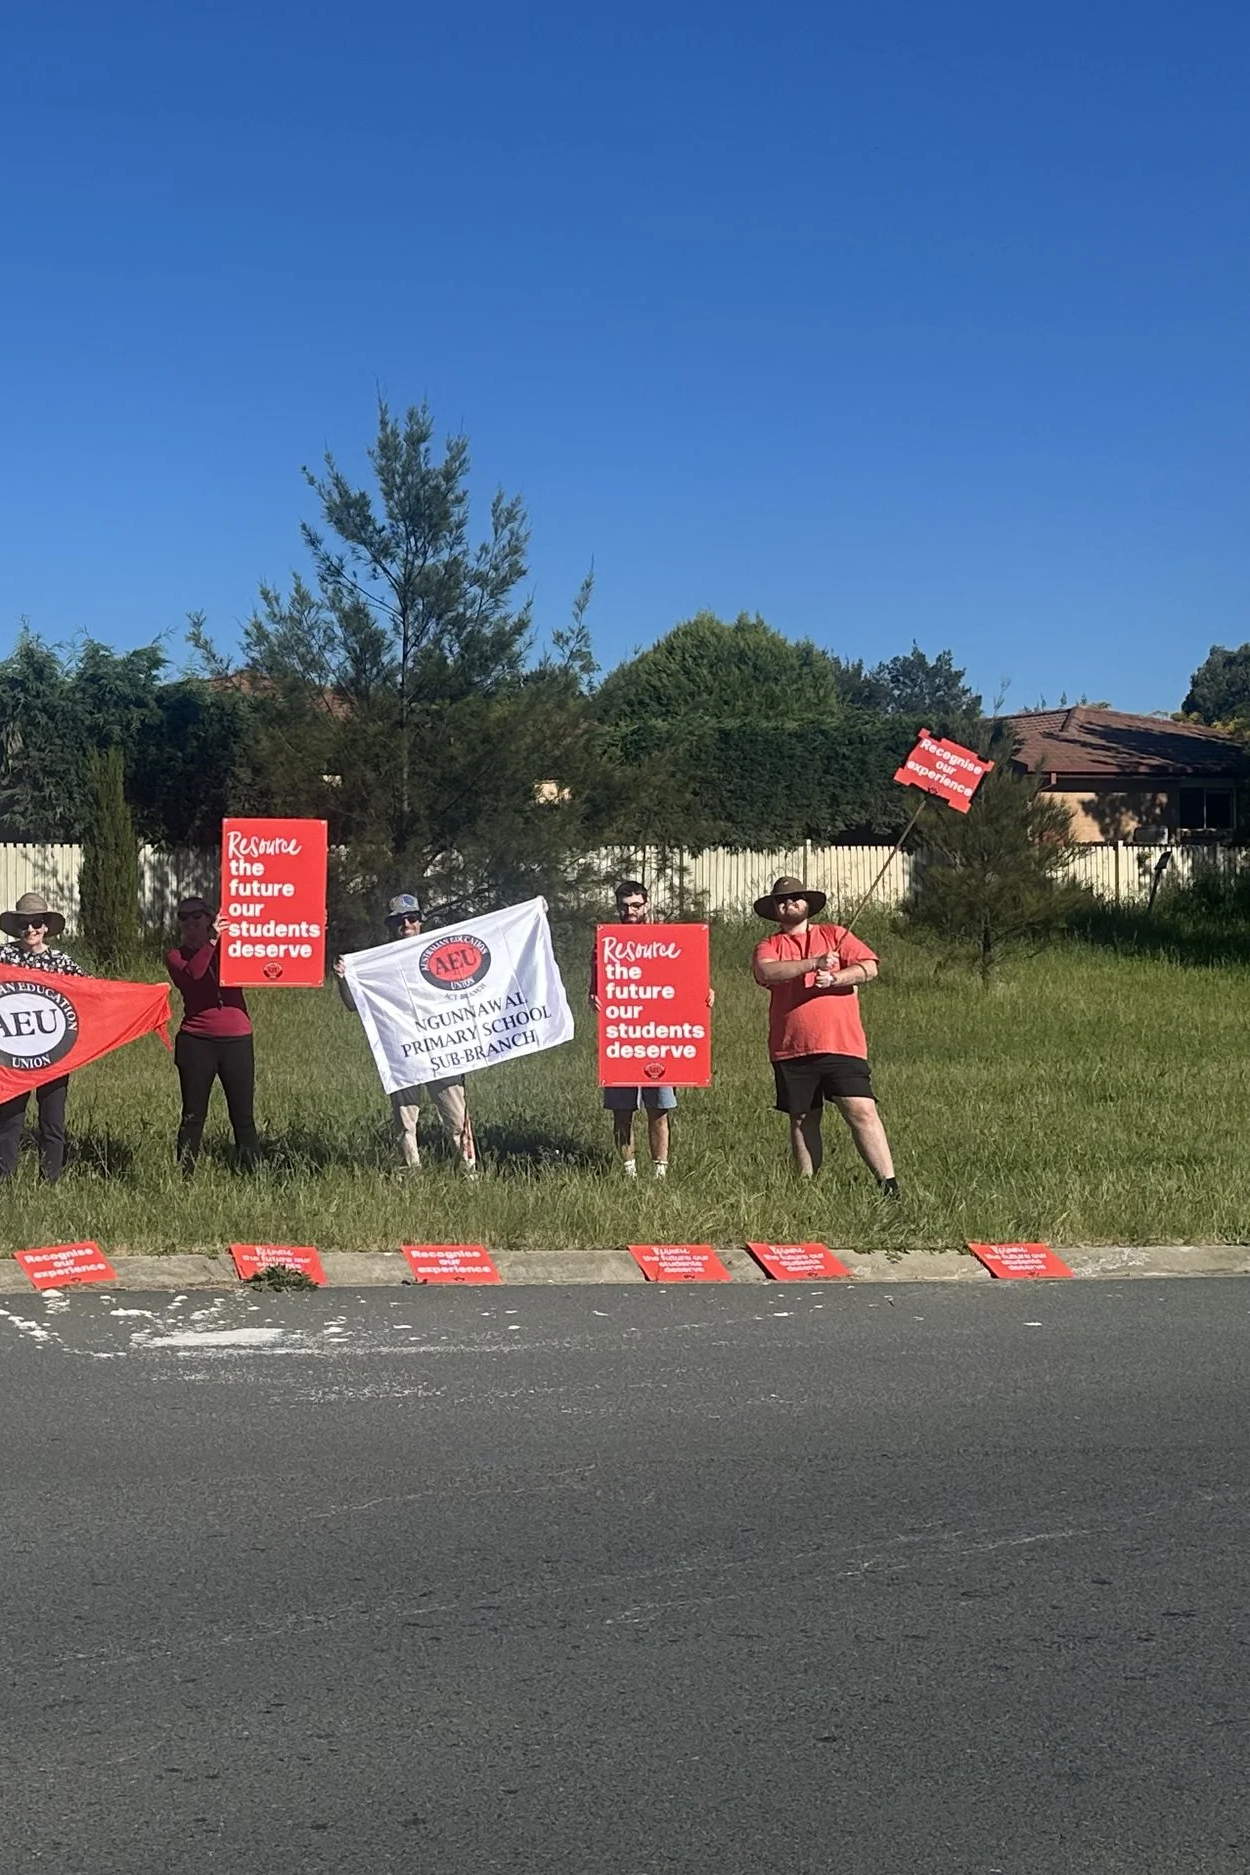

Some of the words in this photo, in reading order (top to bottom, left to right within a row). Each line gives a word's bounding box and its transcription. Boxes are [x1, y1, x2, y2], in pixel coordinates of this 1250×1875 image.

[920, 739, 982, 775] Recognise
[935, 761, 957, 775] our
[906, 761, 972, 797] experience
[227, 830, 302, 859] Resource
[229, 859, 264, 876] the
[229, 878, 295, 896] future
[229, 903, 264, 917] our
[228, 920, 320, 937] students
[228, 940, 312, 958] deserve
[602, 936, 681, 964] Resource
[435, 948, 477, 975] AEU
[605, 964, 641, 979] the
[606, 982, 675, 999] future
[19, 982, 78, 1032] EDUCATION
[415, 992, 528, 1033] NGUNNAWAL
[606, 1005, 643, 1019] our
[402, 1026, 478, 1058] PRIMARY
[483, 1005, 552, 1037] SCHOOL
[606, 1022, 705, 1038] students
[430, 1029, 536, 1072] SUB-BRANCH
[606, 1042, 696, 1058] deserve
[12, 1054, 52, 1069] UNION
[53, 1259, 75, 1268] our
